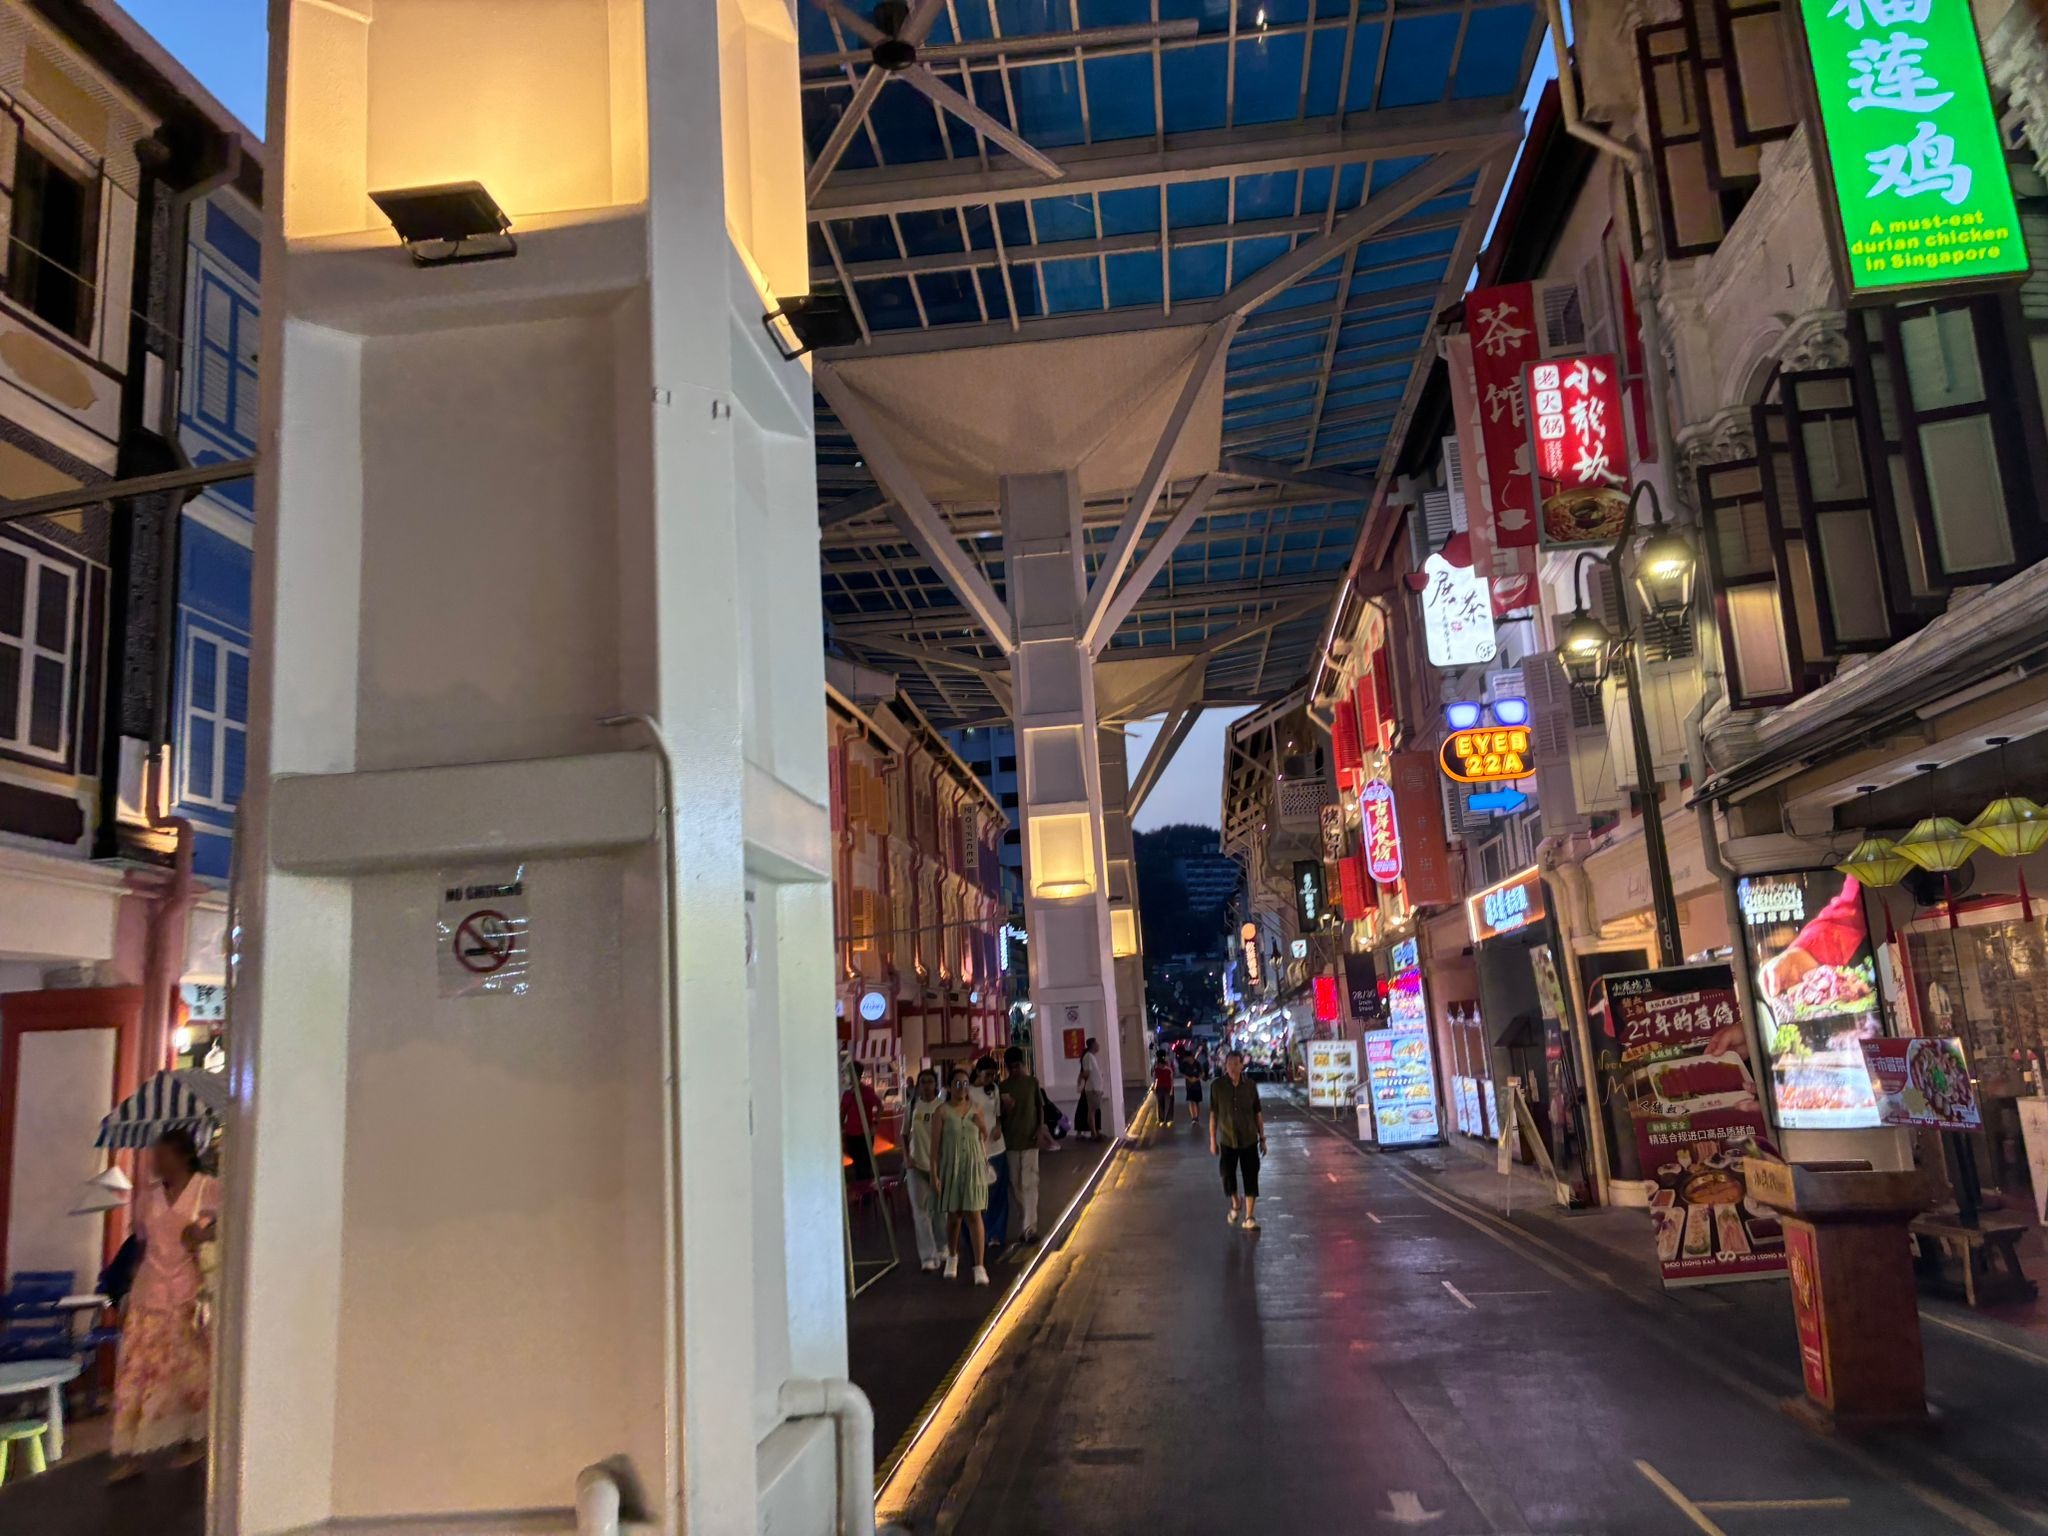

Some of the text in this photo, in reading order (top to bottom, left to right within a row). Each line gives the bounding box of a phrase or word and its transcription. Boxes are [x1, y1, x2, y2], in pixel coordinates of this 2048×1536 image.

[1870, 210, 1984, 236] A must-eat
[1851, 226, 2009, 255] durian chicken
[1866, 245, 2001, 272] in Singapore
[1465, 751, 1524, 776] 22A
[1661, 917, 1674, 949] 18
[1648, 1124, 1756, 1145] 精选合规进口高品质猪血
